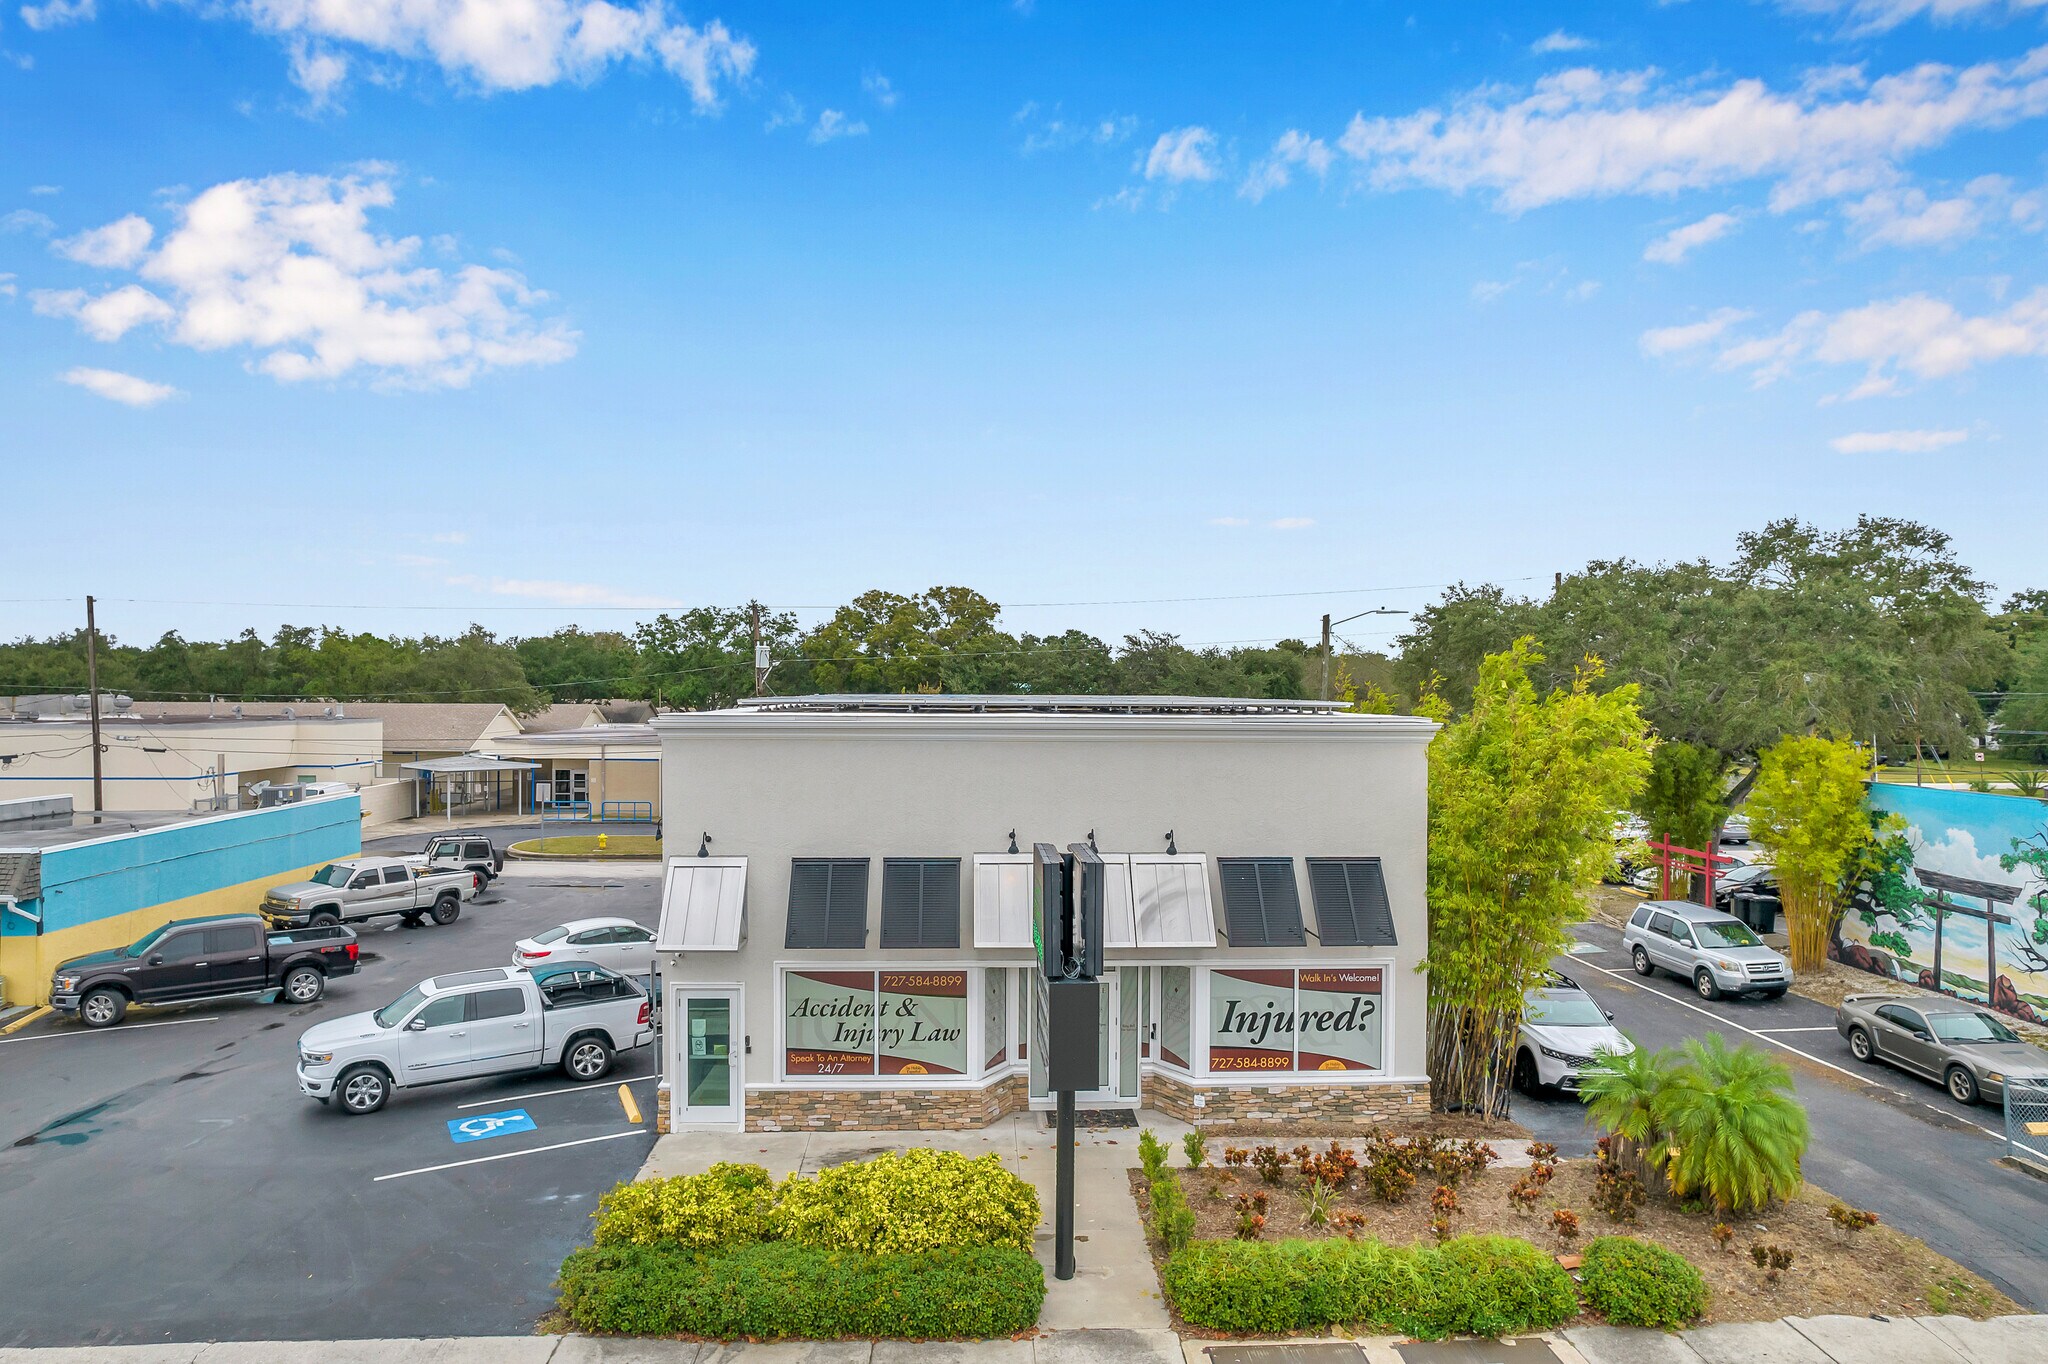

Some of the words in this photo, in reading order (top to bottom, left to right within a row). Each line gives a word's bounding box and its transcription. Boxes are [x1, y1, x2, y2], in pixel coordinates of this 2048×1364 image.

[883, 975, 962, 987] 727-584-8899
[1299, 973, 1321, 983] Walk
[1323, 973, 1337, 983] In's
[1339, 972, 1380, 982] Welcome!
[789, 995, 890, 1018] Accident
[895, 997, 919, 1017] &
[1217, 996, 1376, 1045] Injured?
[832, 1021, 905, 1049] Injury
[909, 1021, 961, 1042] Law
[790, 1053, 814, 1064] Speak
[816, 1053, 825, 1062] To
[827, 1054, 838, 1062] An
[840, 1054, 872, 1064] Attorney
[1211, 1057, 1290, 1069] 727-584-8899
[817, 1063, 845, 1074] 24/7
